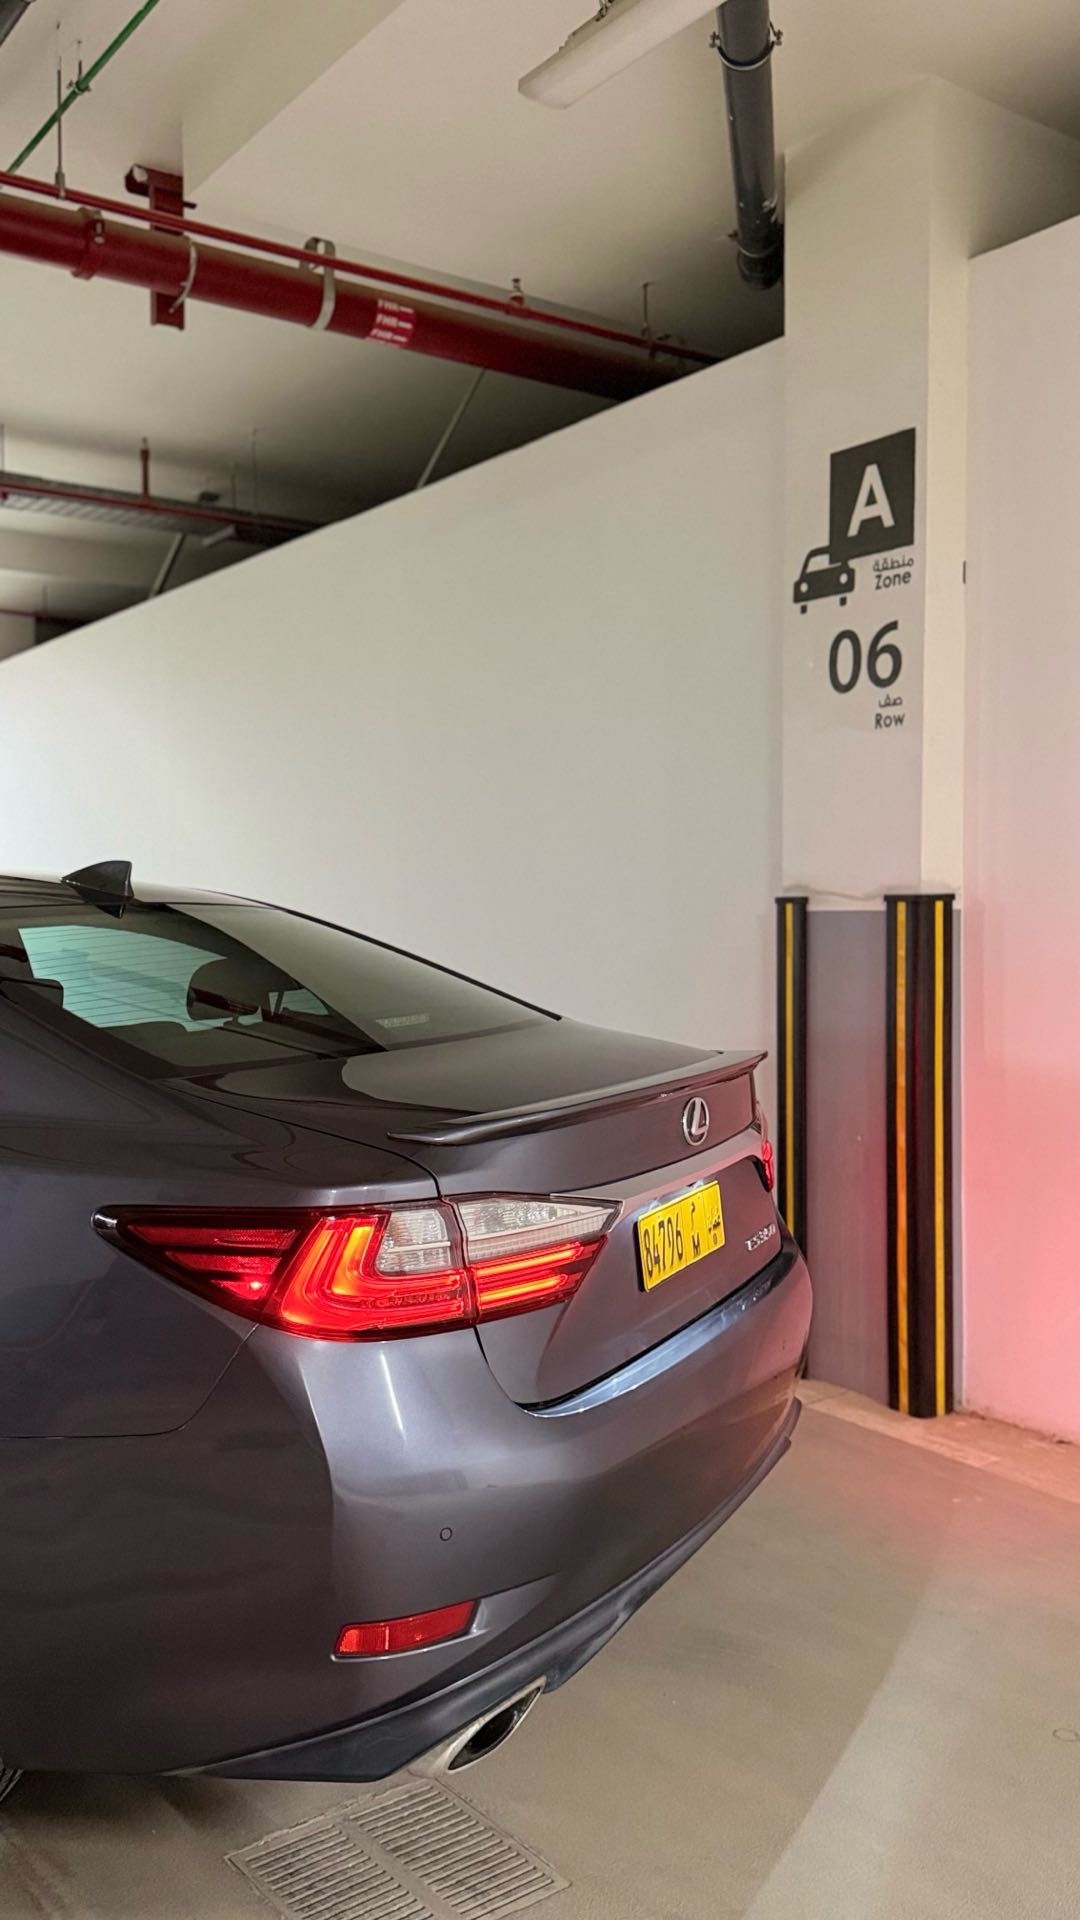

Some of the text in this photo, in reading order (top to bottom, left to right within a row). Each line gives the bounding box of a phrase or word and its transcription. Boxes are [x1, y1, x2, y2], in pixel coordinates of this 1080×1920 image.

[376, 313, 398, 327] FHR
[847, 462, 896, 537] A
[873, 554, 914, 572] منطقة
[875, 571, 911, 590] Zone
[829, 619, 902, 694] 06
[878, 694, 903, 708] صف
[644, 1211, 684, 1278] 84796
